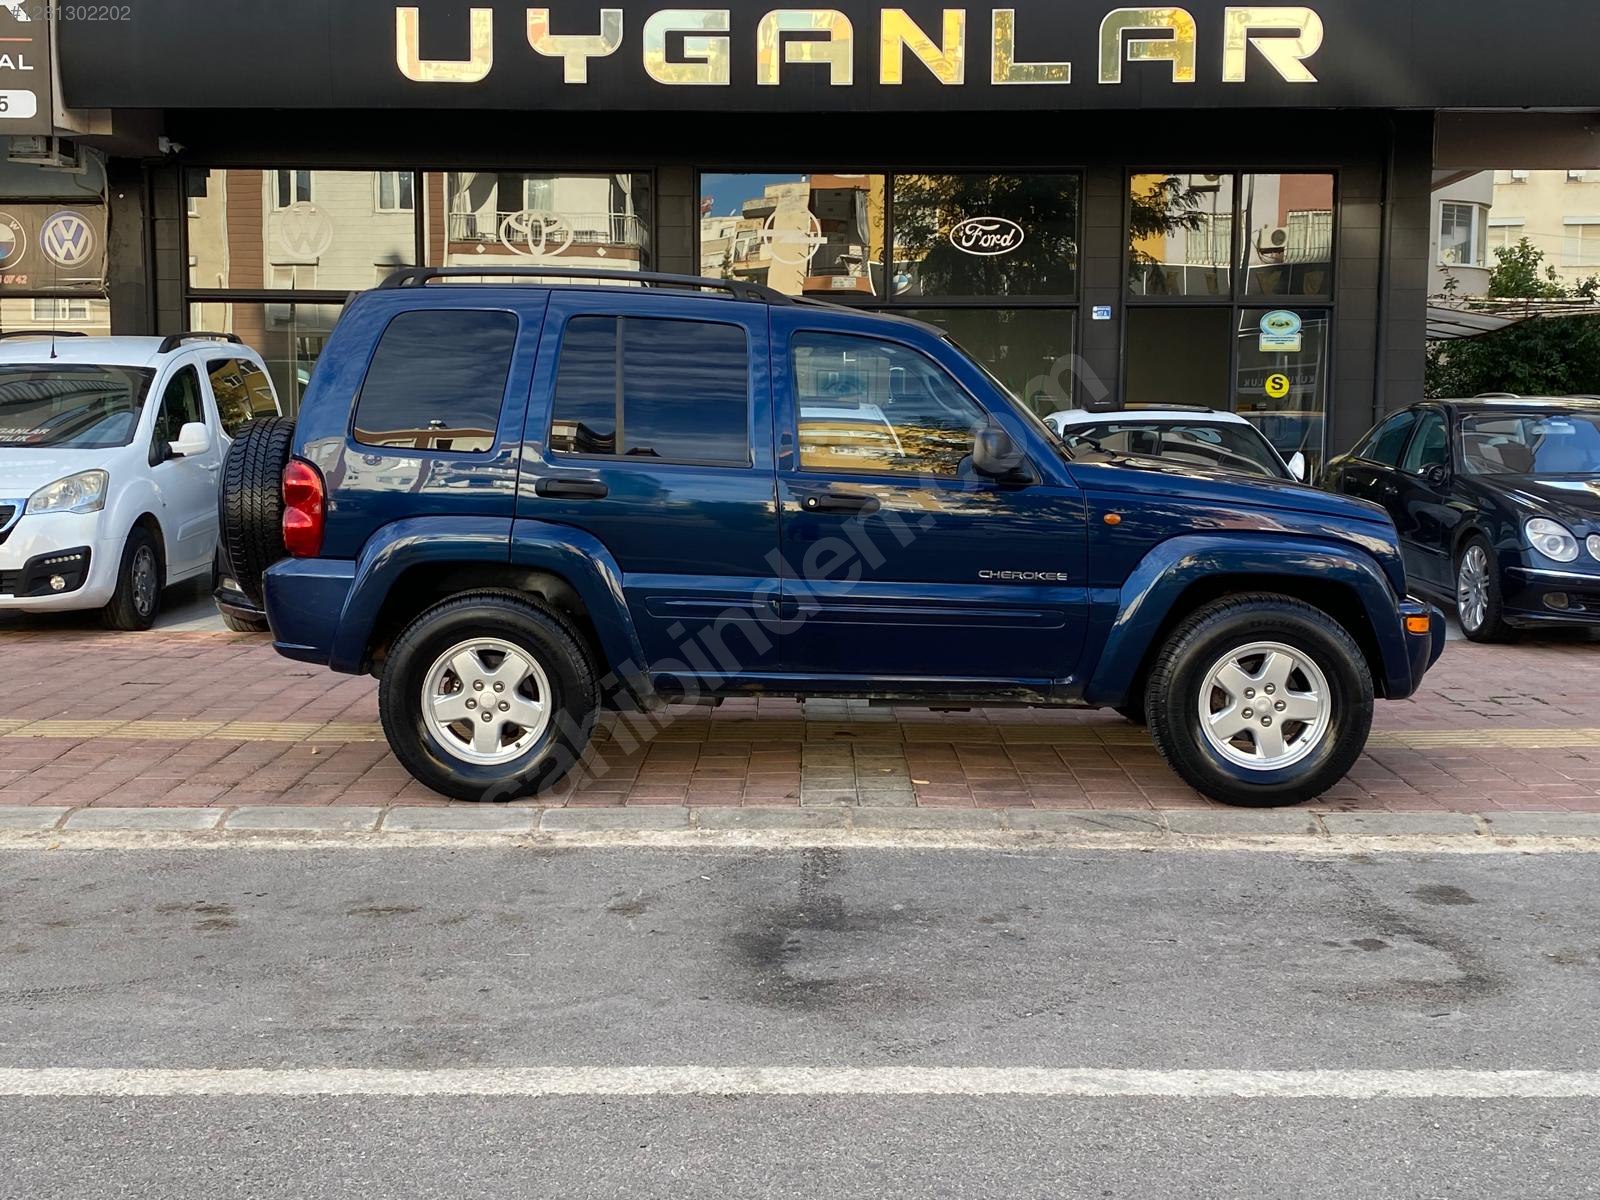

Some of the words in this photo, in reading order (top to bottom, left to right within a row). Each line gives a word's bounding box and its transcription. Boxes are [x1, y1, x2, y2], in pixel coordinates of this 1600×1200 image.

[396, 7, 1324, 86] UYGANLAR
[961, 223, 1016, 247] Ford
[1271, 376, 1284, 390] S
[978, 570, 1068, 581] CHEROKEE
